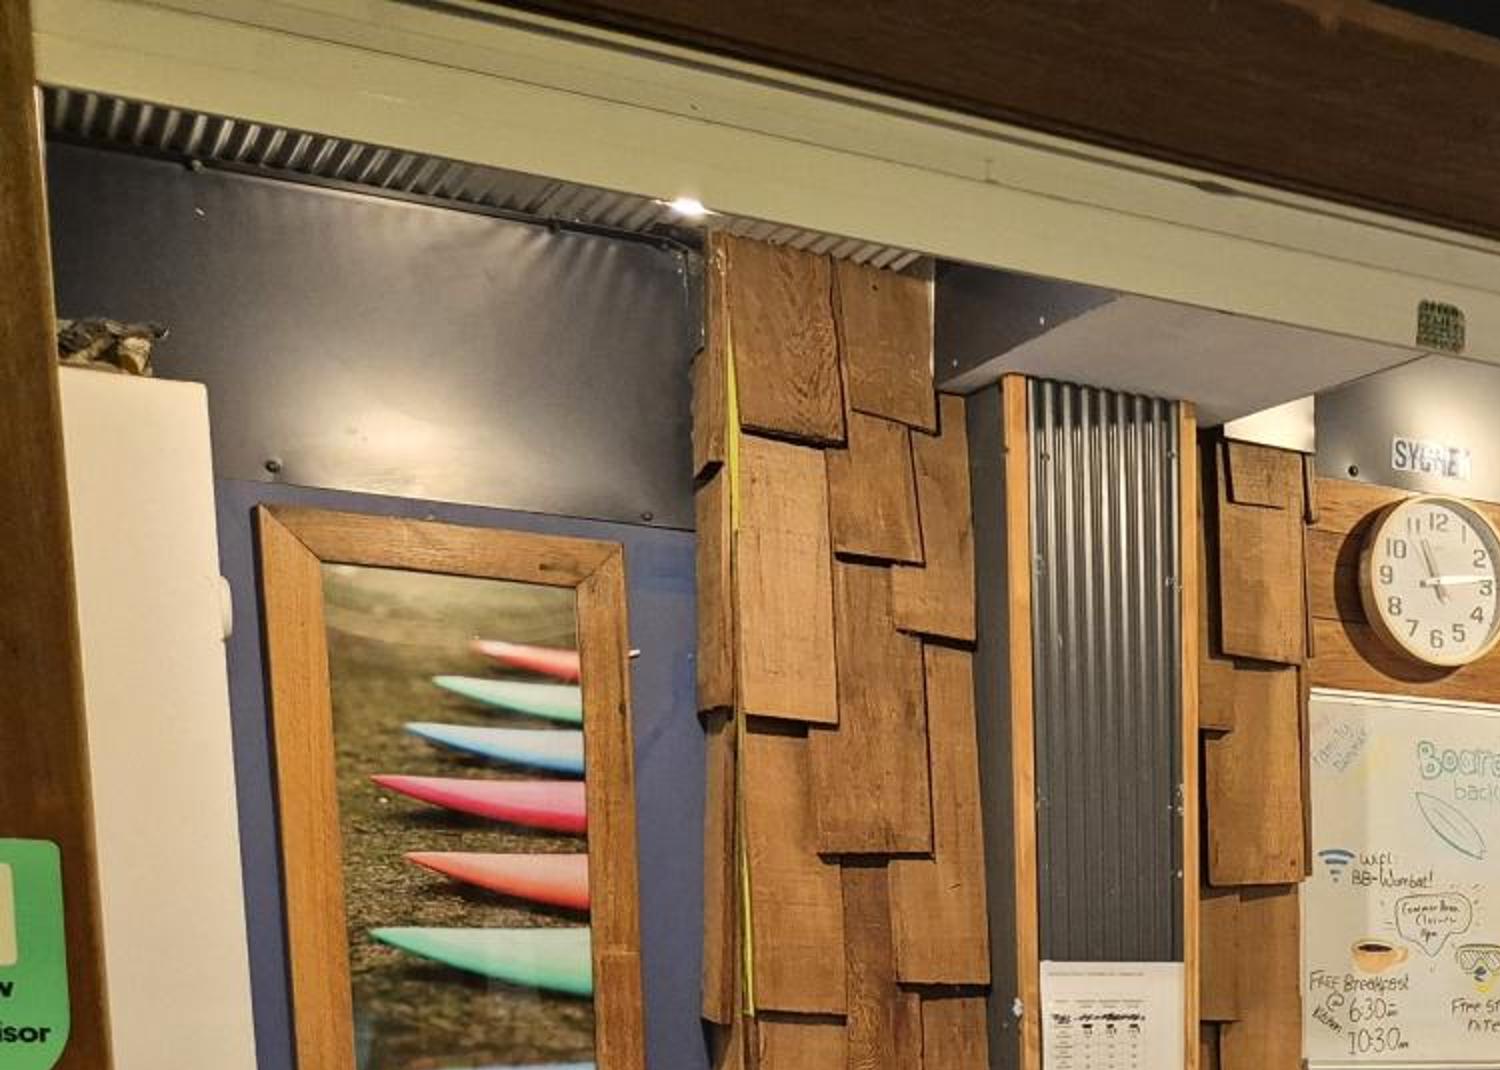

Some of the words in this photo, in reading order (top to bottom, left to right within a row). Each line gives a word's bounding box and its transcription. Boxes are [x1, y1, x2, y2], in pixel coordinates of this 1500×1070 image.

[1407, 517, 1421, 536] 11
[1429, 512, 1449, 532] 12
[1386, 538, 1407, 559] 10
[1473, 550, 1487, 568] 2
[1379, 564, 1393, 585] 9
[1480, 579, 1493, 597] 3
[1388, 596, 1402, 616] 8
[1470, 606, 1484, 623] 4
[1406, 619, 1419, 638] 7
[1452, 624, 1465, 642] 5
[1430, 629, 1444, 649] 6
[1344, 973, 1409, 993] Breakfast
[1326, 990, 1344, 1012] @
[1452, 996, 1481, 1017] Free
